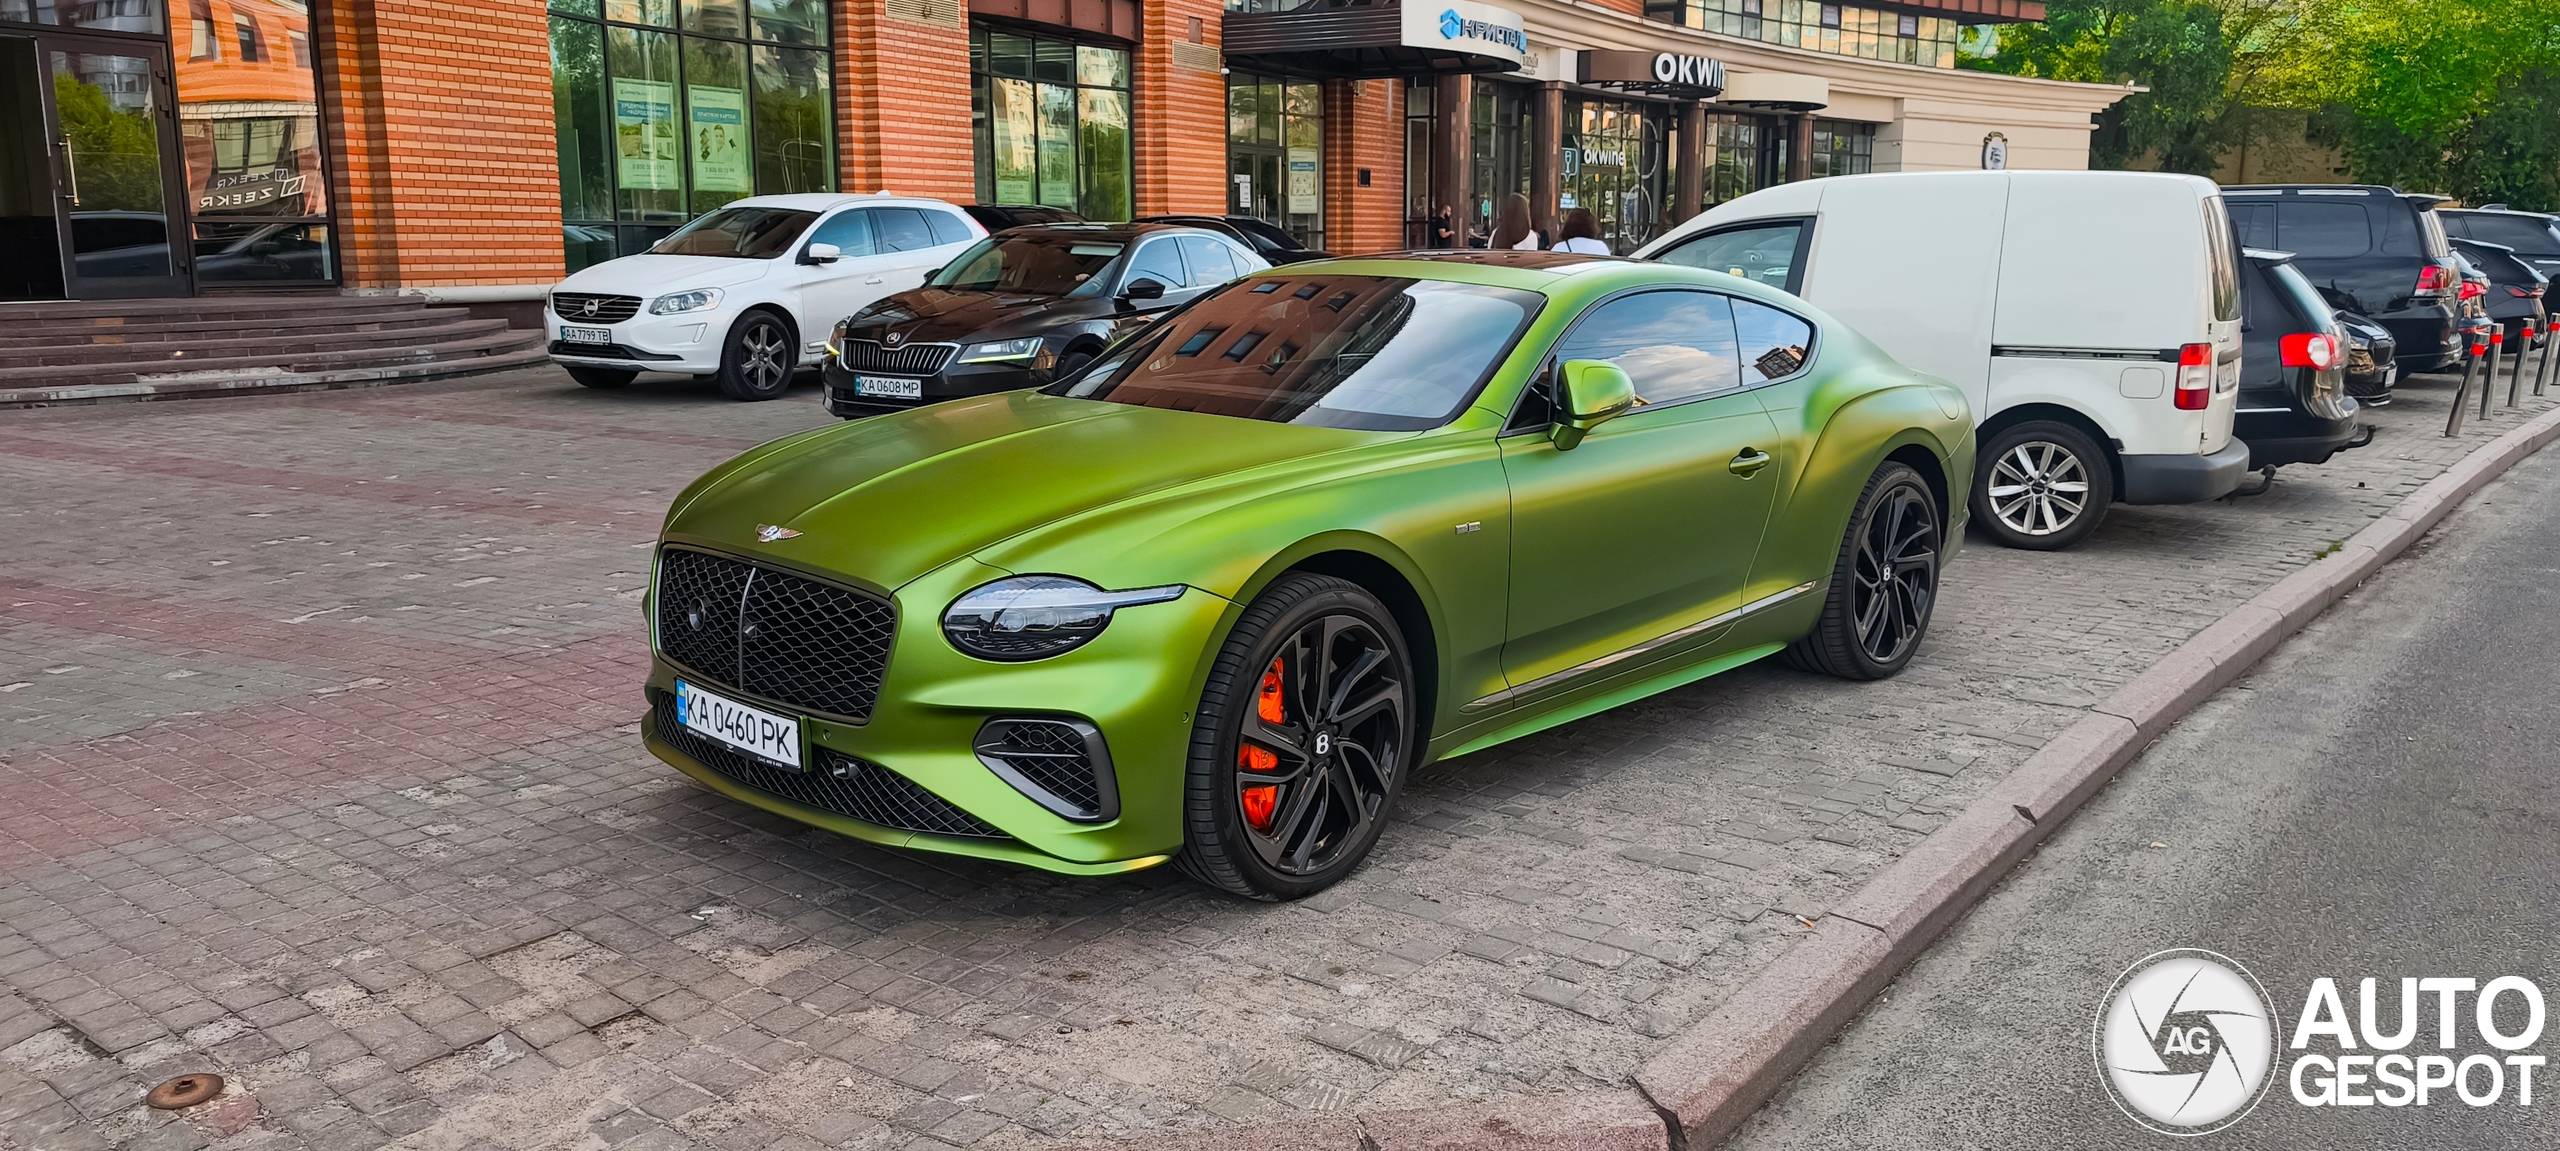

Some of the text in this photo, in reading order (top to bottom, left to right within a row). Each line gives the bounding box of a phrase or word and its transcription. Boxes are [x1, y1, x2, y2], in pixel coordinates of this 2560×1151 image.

[566, 329, 609, 341] AA 7799 TB
[861, 379, 919, 394] KA 0608 MP
[686, 690, 792, 758] KA 0460 PK
